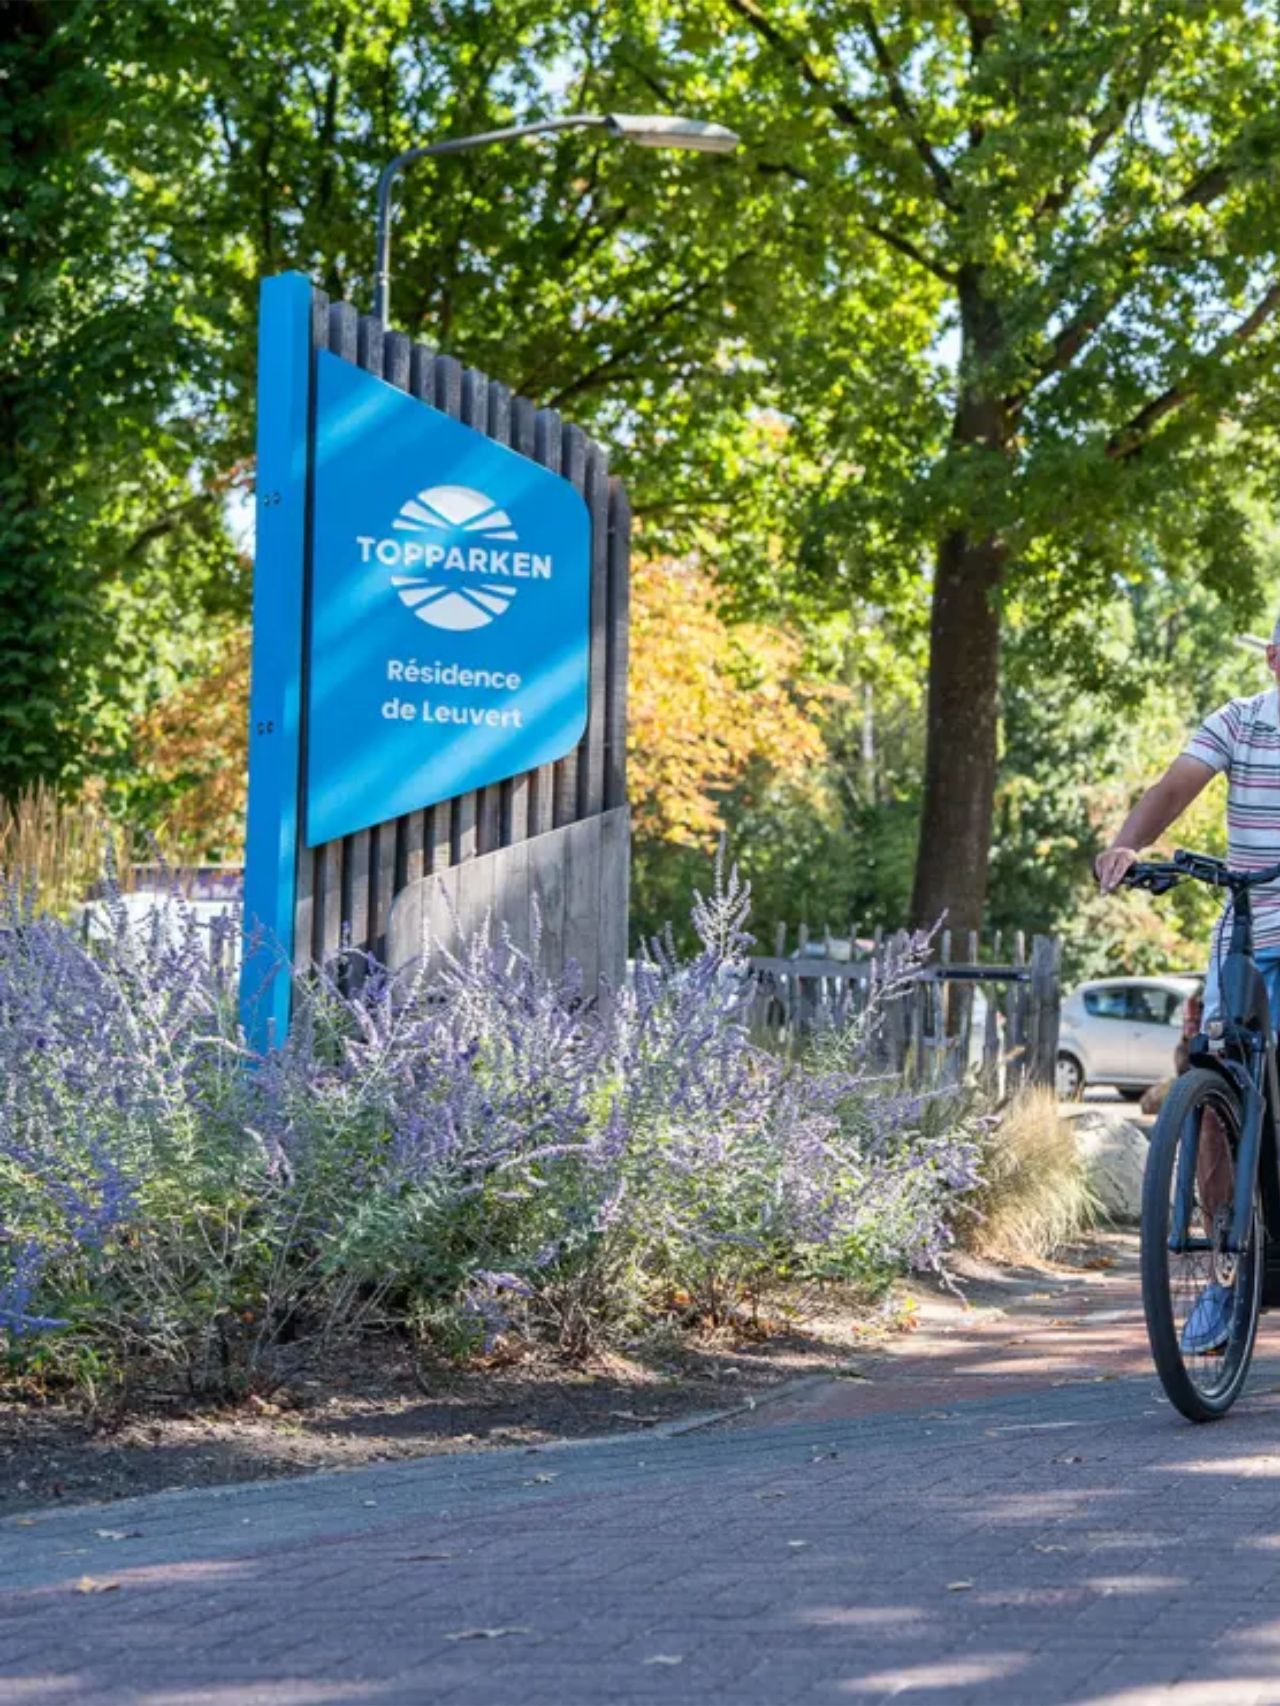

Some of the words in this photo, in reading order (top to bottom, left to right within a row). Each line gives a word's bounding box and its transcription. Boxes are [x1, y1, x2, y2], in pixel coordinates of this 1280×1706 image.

[356, 536, 552, 579] TOPPARKEN
[387, 658, 521, 690] Résidence
[381, 698, 416, 721] de
[422, 700, 522, 728] Leuvert
